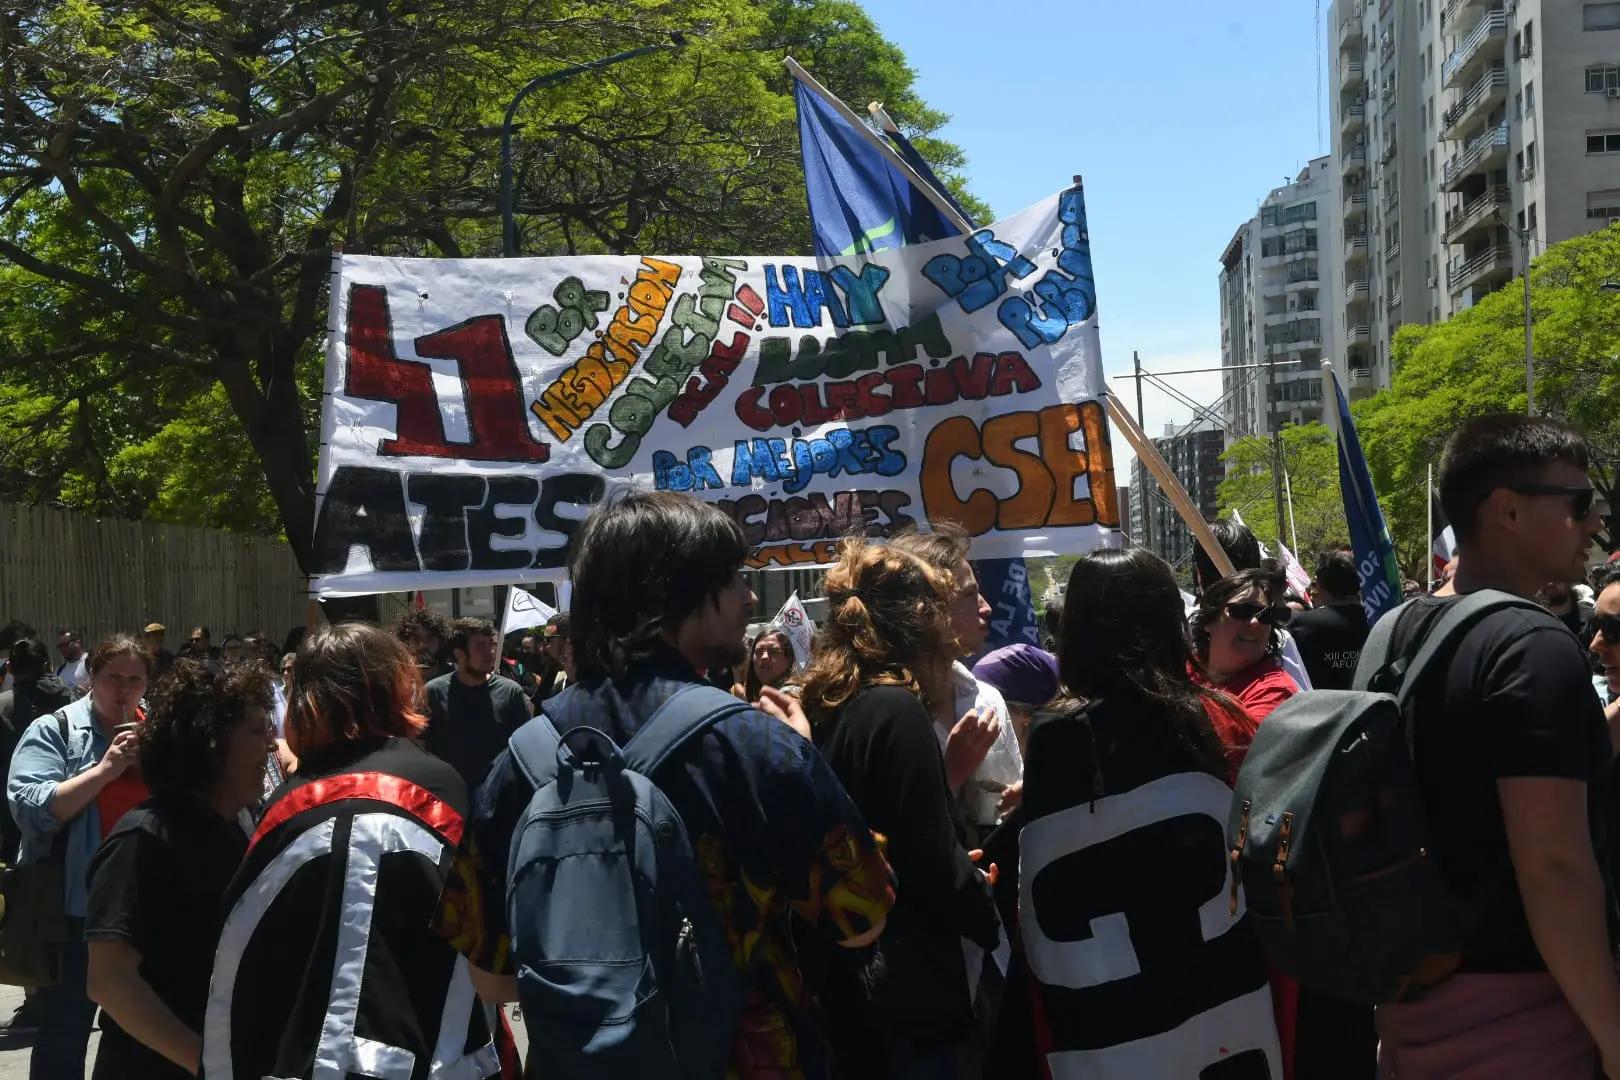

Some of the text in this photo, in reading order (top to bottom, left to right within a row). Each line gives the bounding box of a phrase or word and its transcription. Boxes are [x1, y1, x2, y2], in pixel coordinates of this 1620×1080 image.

[524, 275, 611, 358] POR
[764, 262, 891, 328] HAY
[735, 351, 1043, 432] COLECTIVA
[652, 424, 908, 494] POR MEJORES
[311, 465, 606, 575] ATES
